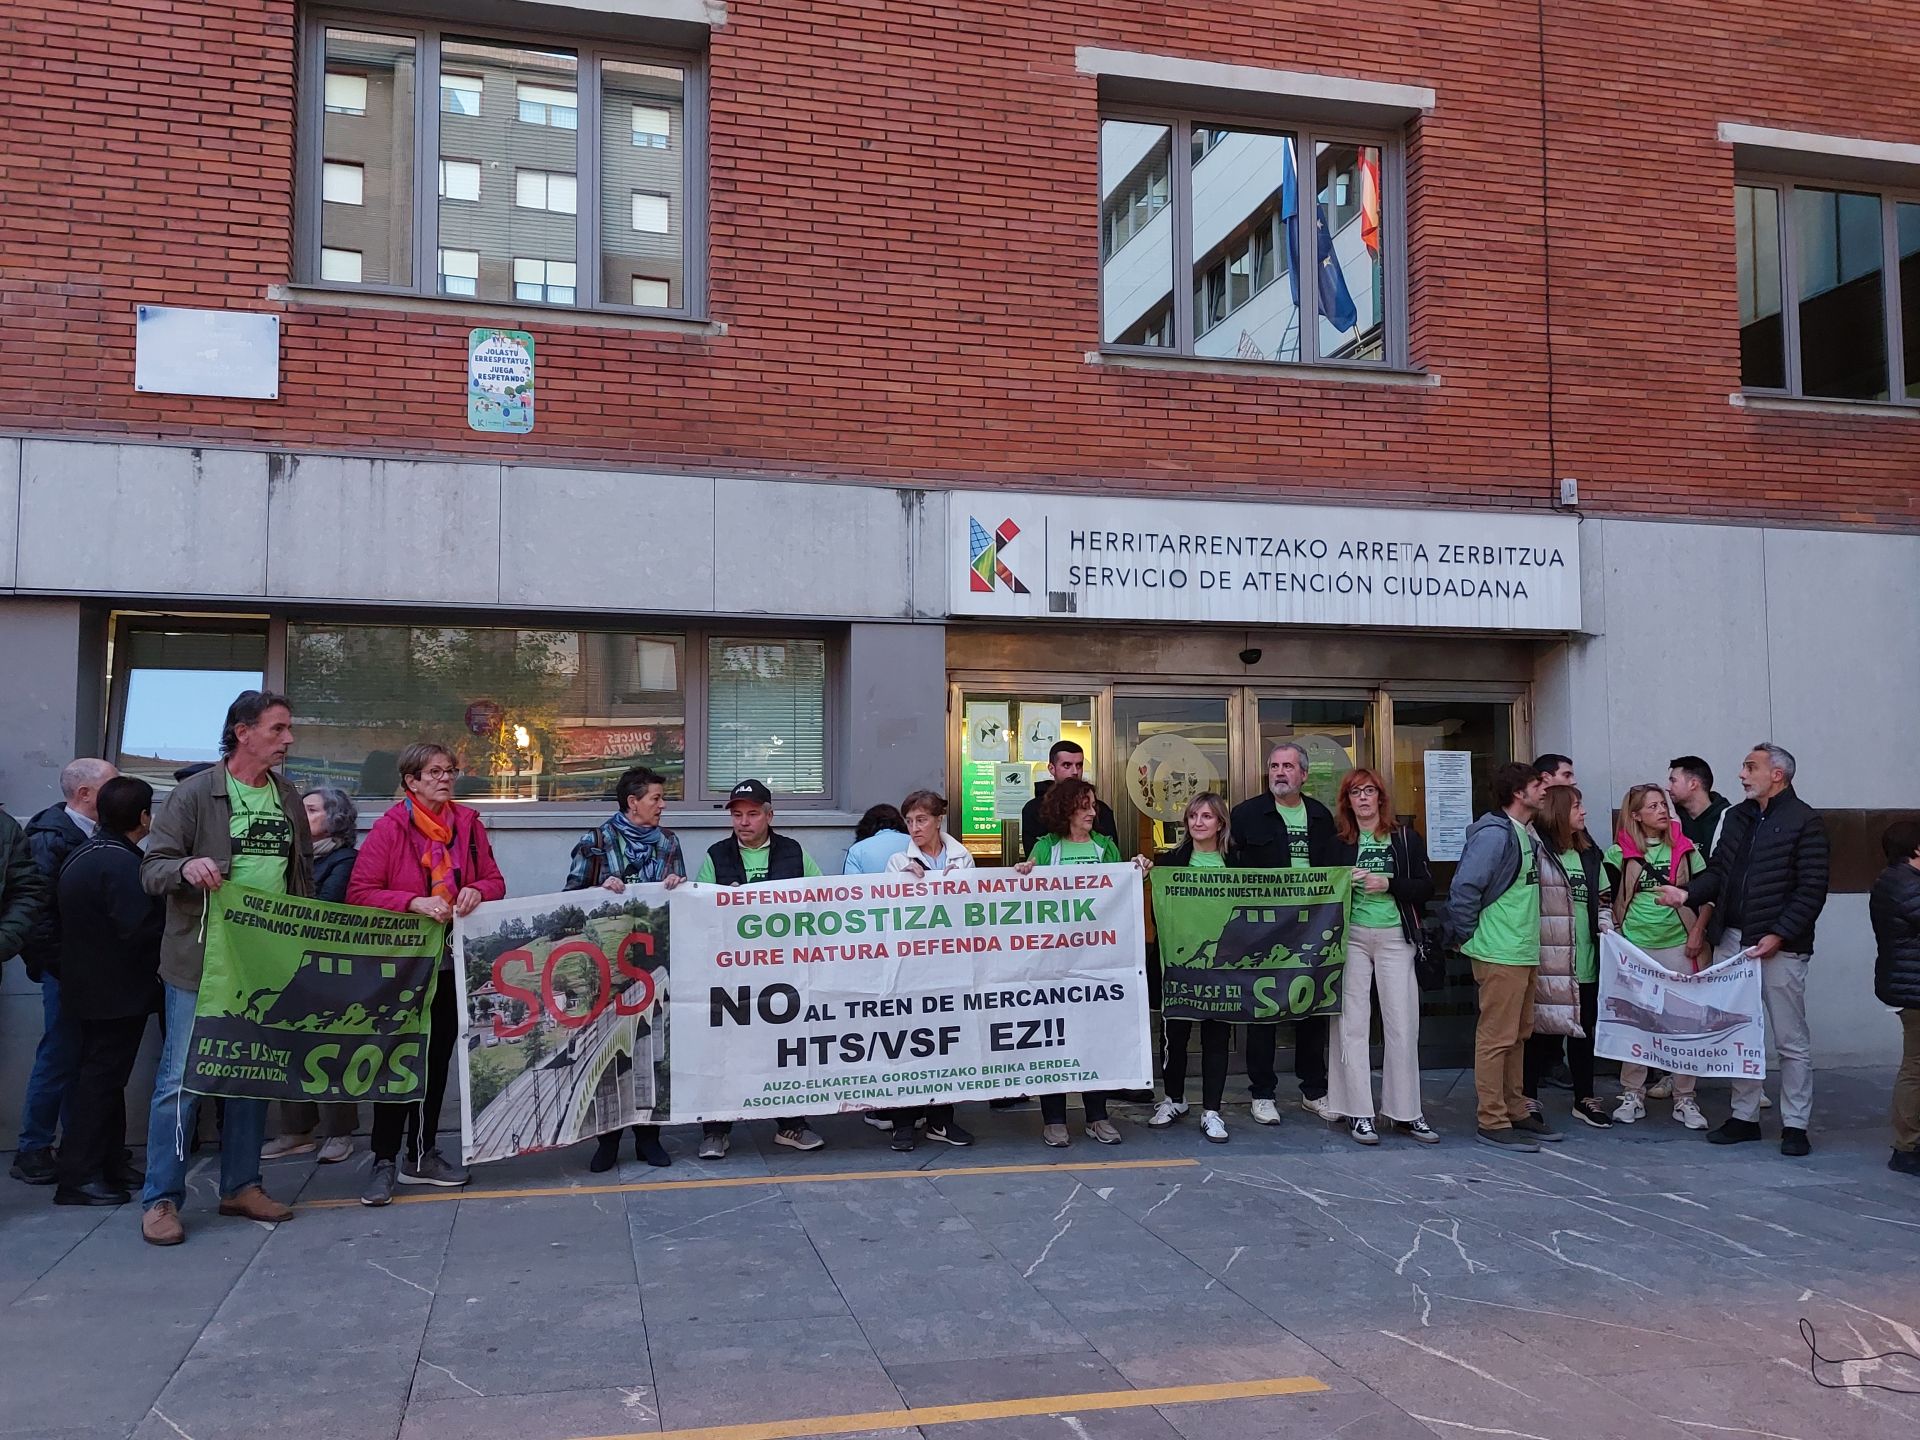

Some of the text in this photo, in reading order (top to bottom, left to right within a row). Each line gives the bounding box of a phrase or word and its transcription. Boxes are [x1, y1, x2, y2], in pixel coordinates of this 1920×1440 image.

[475, 355, 529, 365] ERRESPETATUZ
[486, 348, 519, 356] JOLASTU
[478, 374, 525, 383] RESPETANDO
[1070, 529, 1565, 567] HERRITARRENTZAKO ARRETA ZERBITZUA
[1069, 565, 1529, 599] SERVICIO DE ATENCIÓN CIUDADANA
[716, 874, 1114, 907] DEFENDAMOS NUESTRA NATURALEZA
[1165, 885, 1336, 898] DEFENDAMOS NUESTRA NATURALEZA
[1172, 872, 1328, 884] GURE NATURA DEFENDA DEZAGUN
[224, 908, 299, 937] DEFENDAMOS
[299, 925, 351, 944] NUESTRA
[242, 894, 419, 930] GURE NATURA DEFENDA DEZAGUN
[736, 897, 1098, 940] GOROSTIZA BIZIRIK
[716, 929, 1116, 968] GURE NATURA DEFENDA DEZAGUN
[1618, 951, 1666, 980] Variante
[492, 931, 656, 1037] SOS
[709, 982, 1125, 1028] NO AL TREN DE MERCANCIAS
[1210, 1002, 1242, 1012] BIZIRIK
[777, 1017, 1066, 1068] HTS/VSF EZ!!
[1631, 1043, 1761, 1075] Saihesbide honi Ez
[1652, 1036, 1761, 1059] Hegoaldeko Tren
[196, 1061, 266, 1080] GOROSTIZA
[762, 1058, 1081, 1092] AUZO-ELKARTEA GOROSTIZAKO BIRIKA BERDEA
[743, 1070, 1099, 1108] ASOCIACION VECINAL PULMON VERDE DE GOROSTIZA
